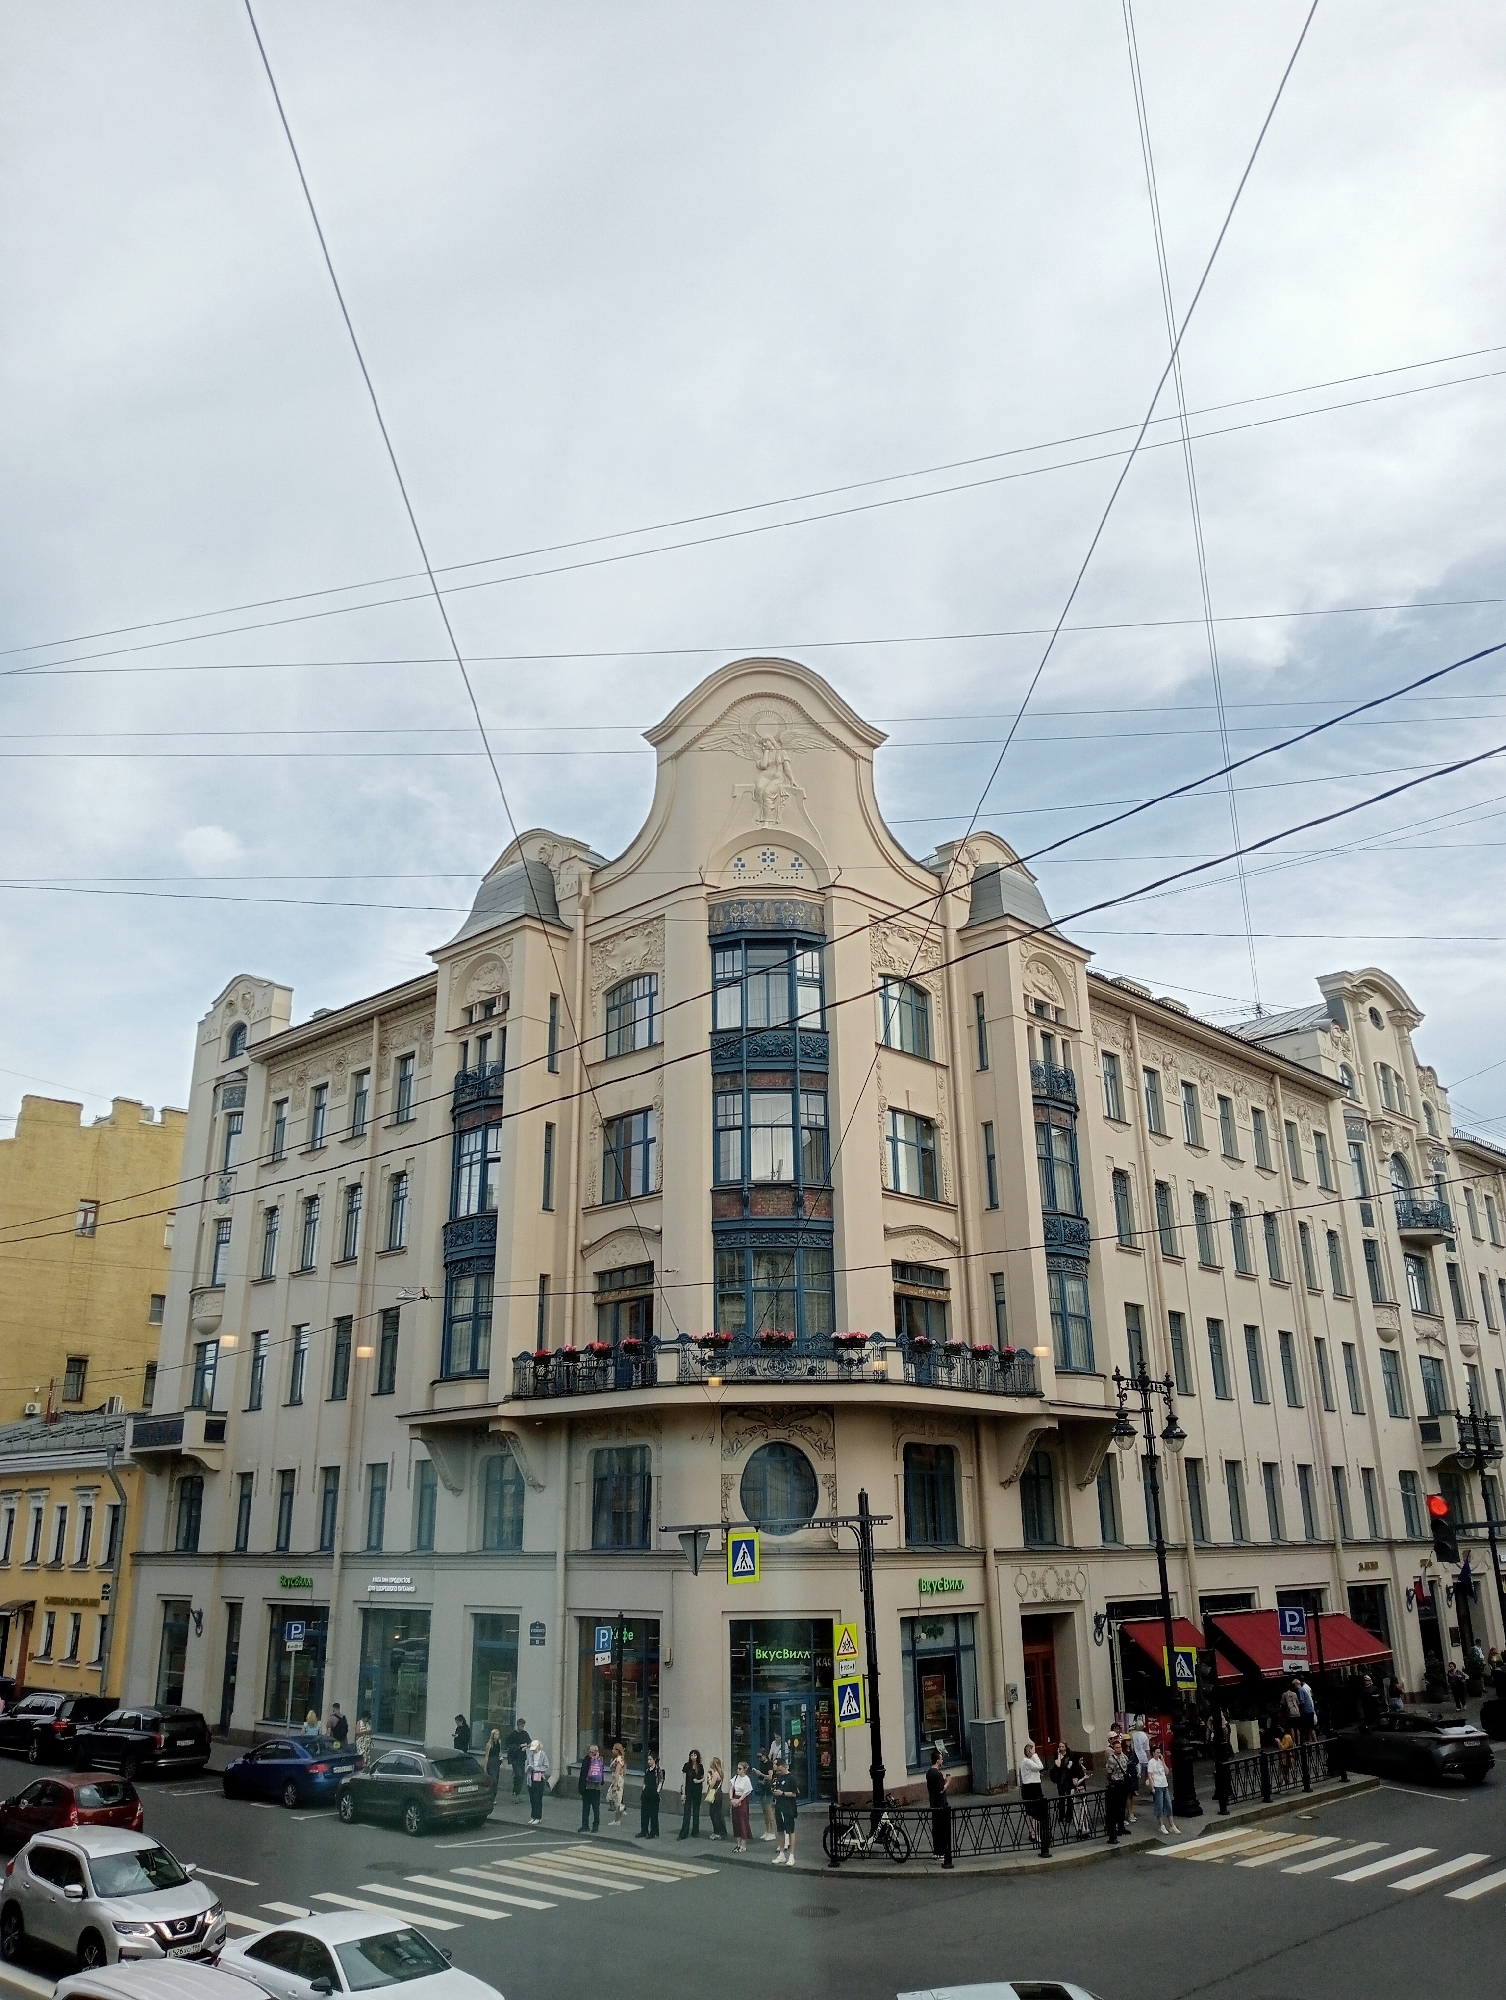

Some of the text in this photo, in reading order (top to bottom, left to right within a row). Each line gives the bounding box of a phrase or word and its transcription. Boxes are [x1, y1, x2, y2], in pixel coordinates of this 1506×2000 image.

[920, 1578, 965, 1595] ВкусВилл
[1284, 1610, 1300, 1633] P
[291, 1623, 302, 1639] P
[600, 1629, 609, 1649] P
[755, 1648, 811, 1662] ВкусВилл
